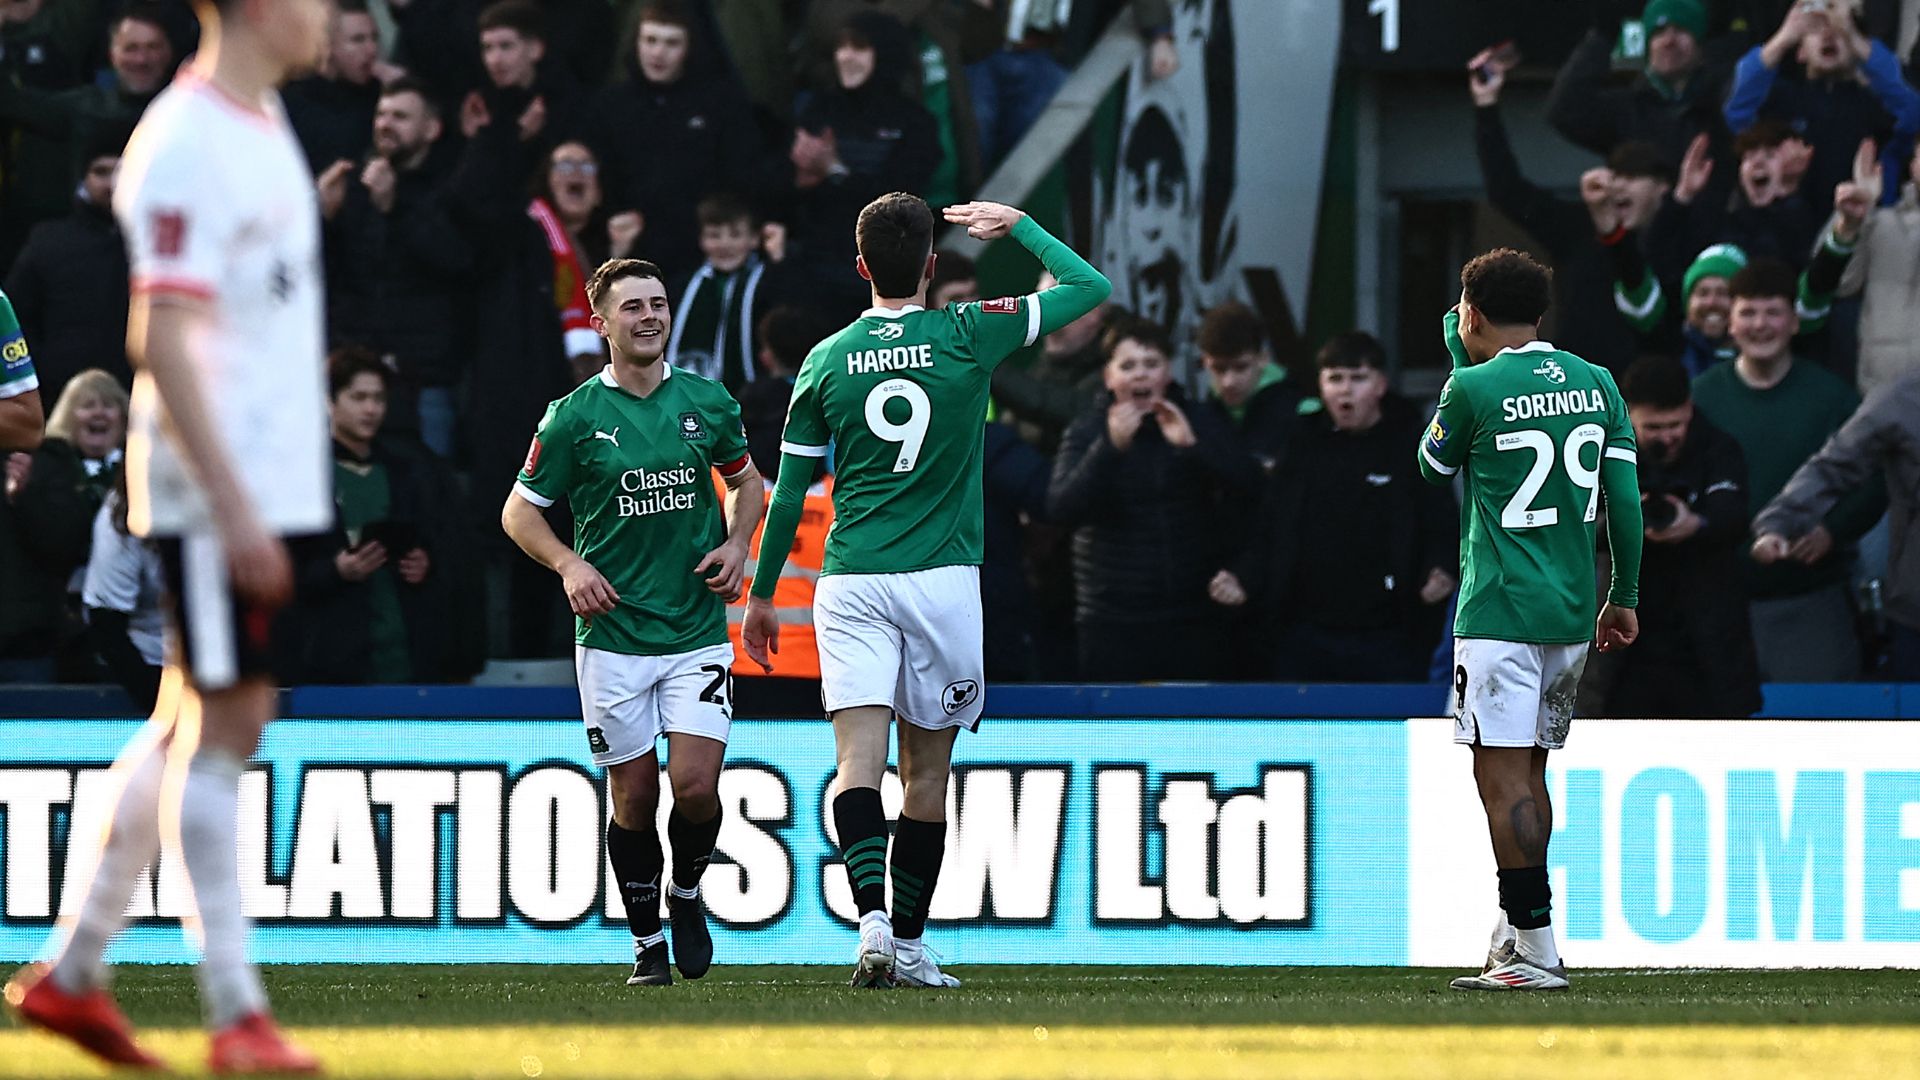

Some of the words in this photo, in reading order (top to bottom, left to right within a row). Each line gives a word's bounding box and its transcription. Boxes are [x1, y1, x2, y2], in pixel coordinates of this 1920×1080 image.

[1367, 0, 1400, 52] 1
[847, 344, 934, 376] HARDIE
[865, 378, 931, 473] 9
[1502, 389, 1606, 422] SORINOLA
[620, 461, 696, 493] Classic
[1495, 423, 1606, 529] 29
[616, 490, 697, 518] Builder
[1095, 766, 1309, 923] Ltd
[1547, 766, 1920, 944] HOME
